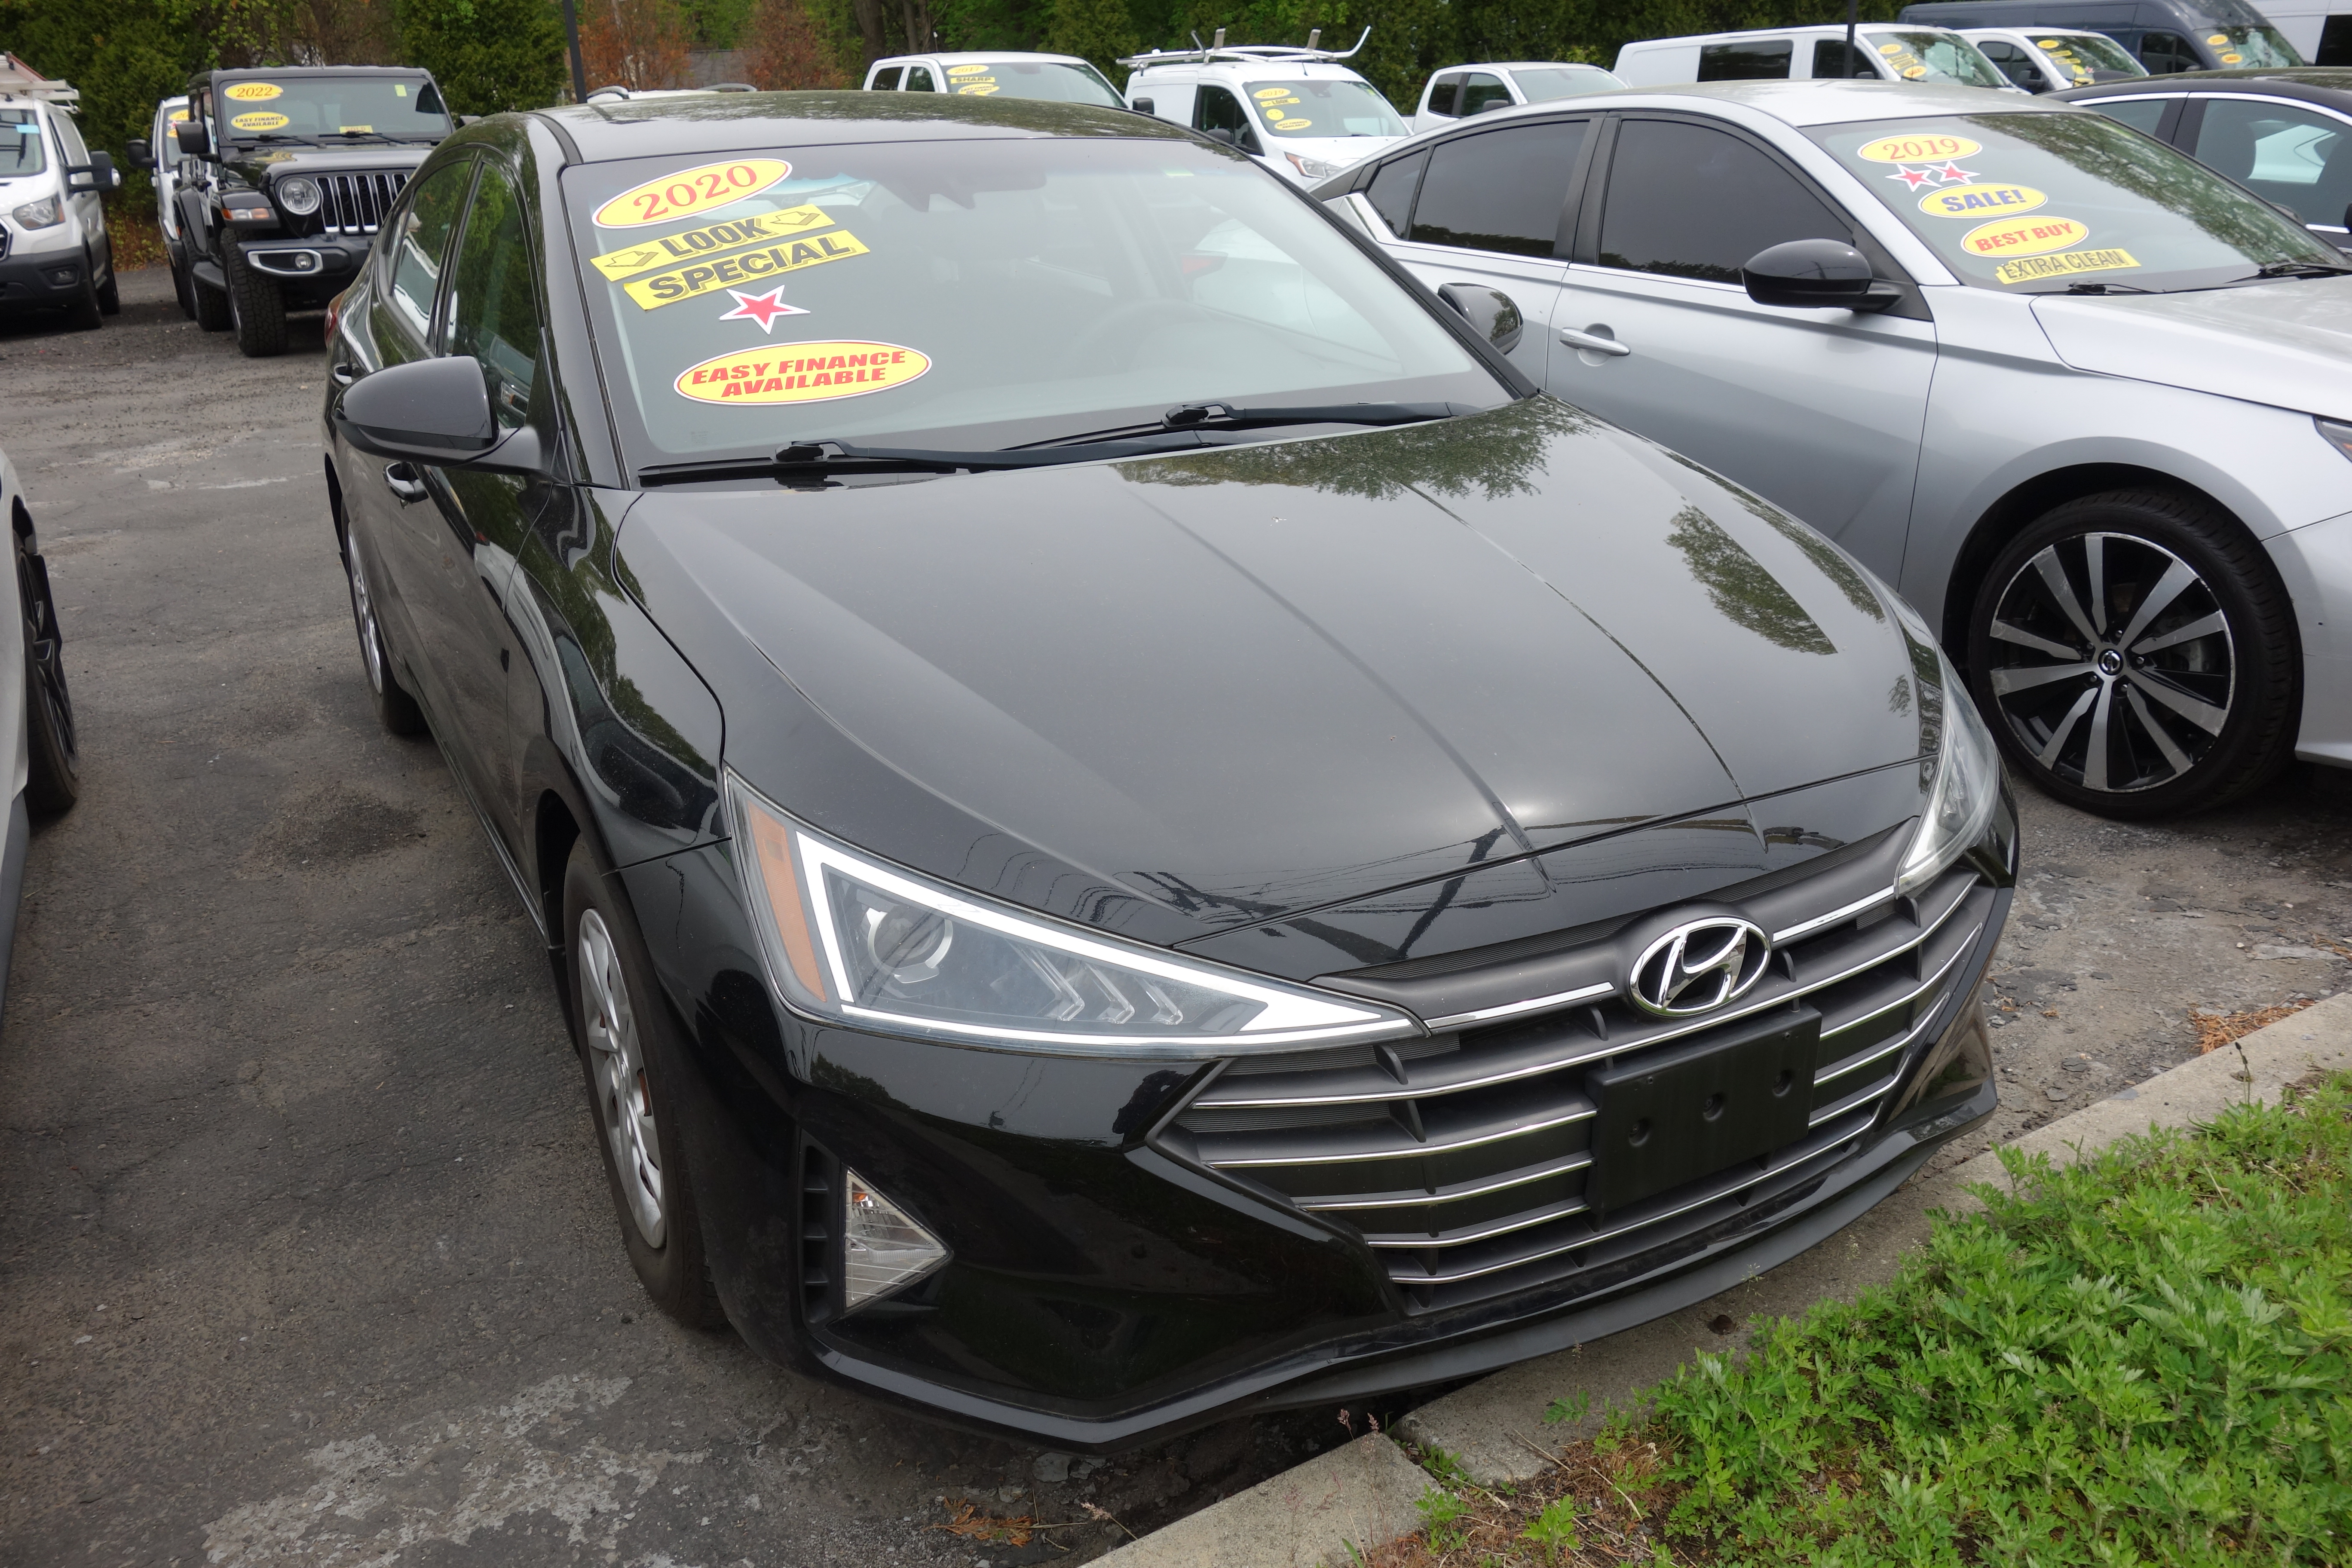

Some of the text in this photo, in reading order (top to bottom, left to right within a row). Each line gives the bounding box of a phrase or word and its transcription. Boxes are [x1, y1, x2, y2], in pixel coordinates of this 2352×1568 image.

[236, 86, 273, 98] 2022
[1883, 138, 1960, 159] 2019
[633, 165, 757, 220] 2020
[1941, 189, 2027, 211] SALE!
[658, 217, 774, 257] LOOK
[1975, 223, 2073, 251] BEST BUY
[648, 237, 854, 300] SPECIAL
[2003, 250, 2127, 279] EXTRA CLEAN
[692, 351, 905, 384] EASY FINANCE
[721, 368, 885, 397] AVAILABLE
